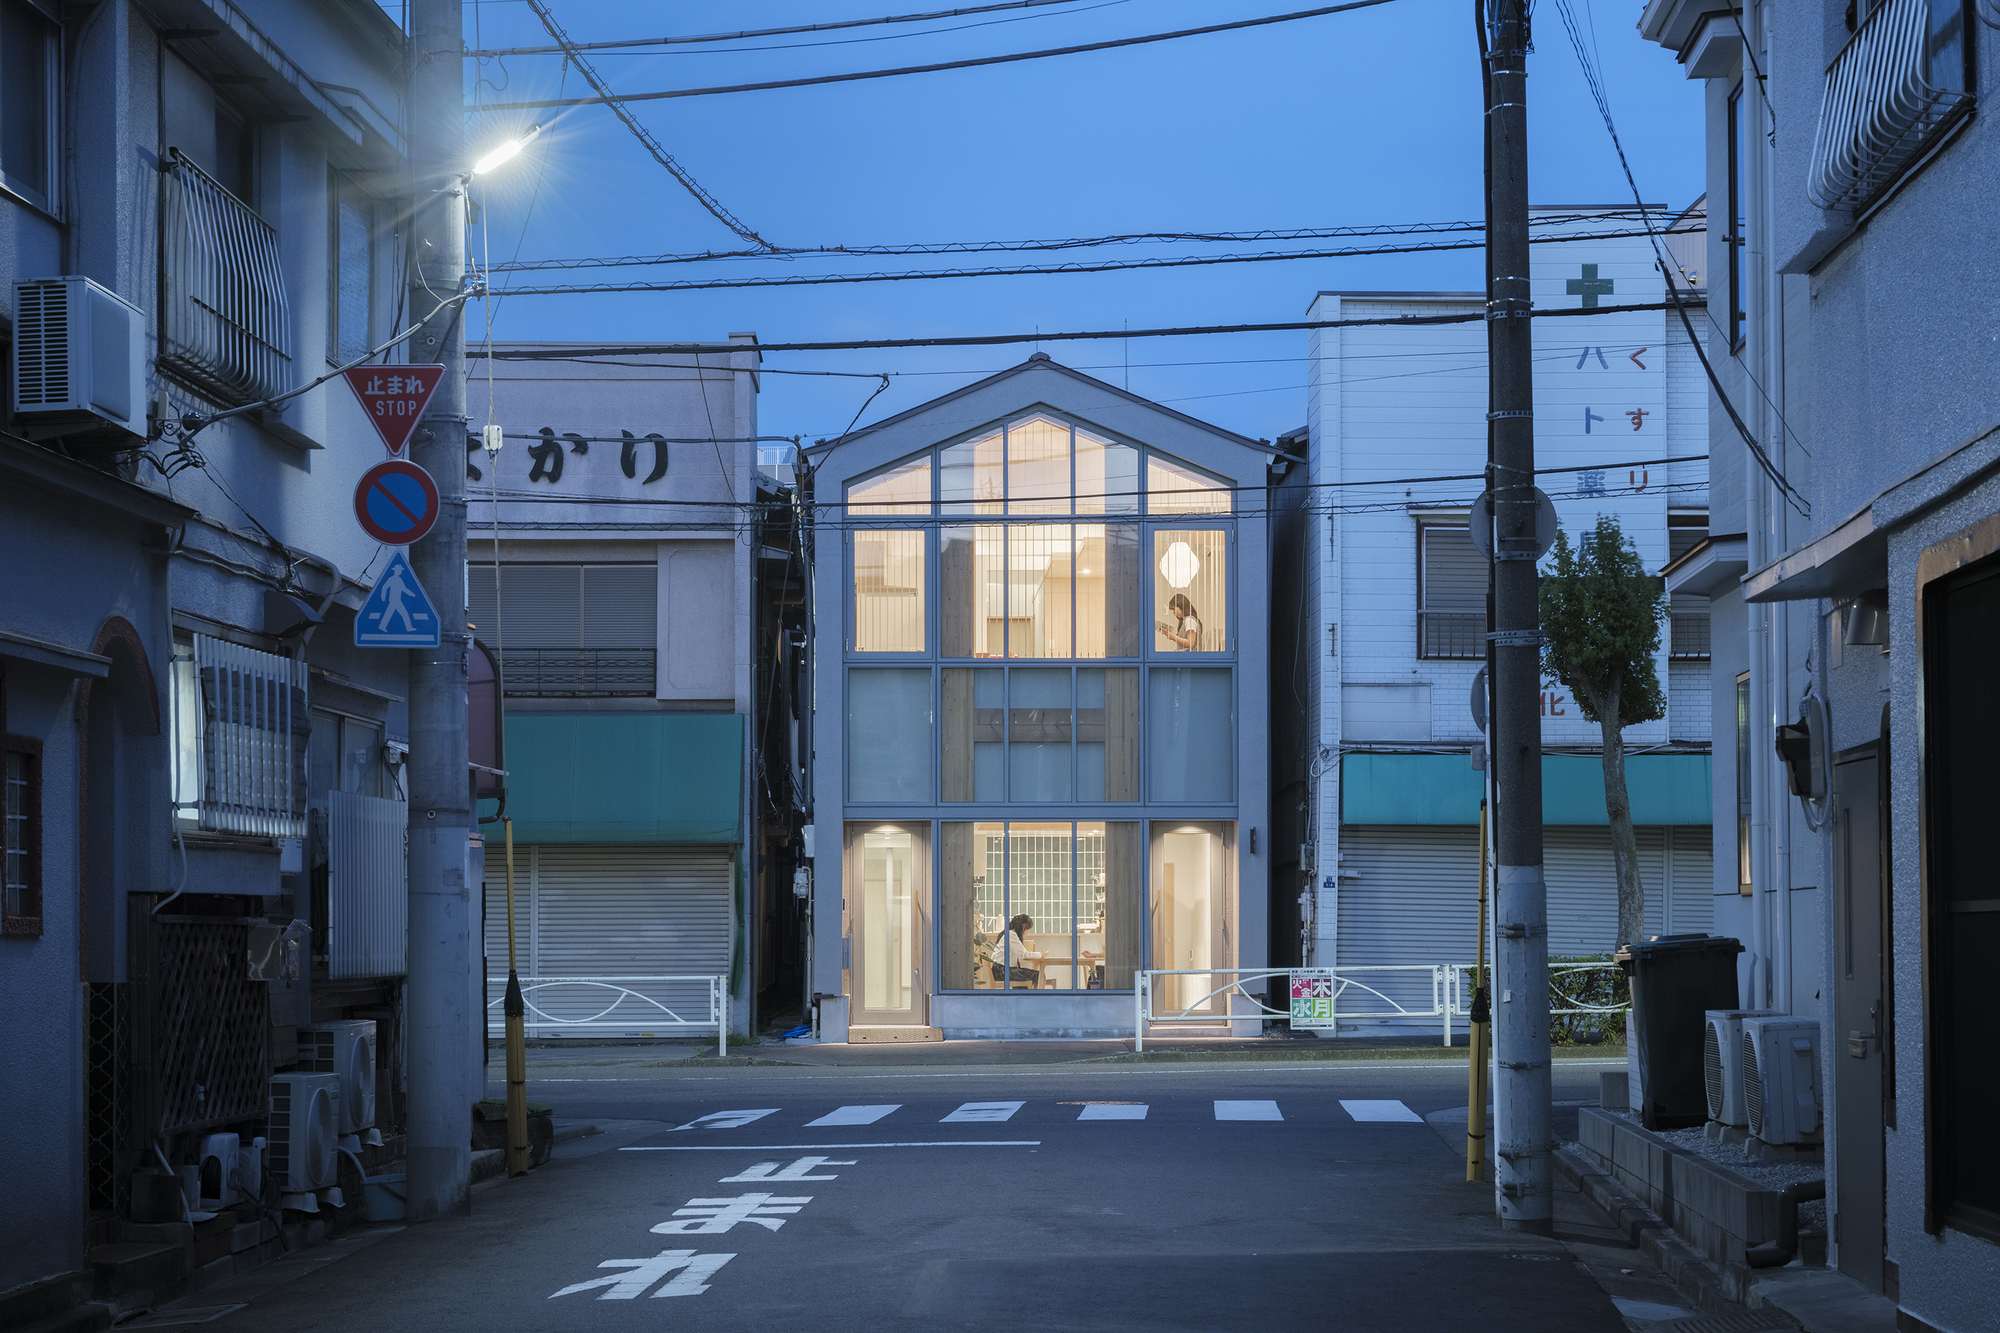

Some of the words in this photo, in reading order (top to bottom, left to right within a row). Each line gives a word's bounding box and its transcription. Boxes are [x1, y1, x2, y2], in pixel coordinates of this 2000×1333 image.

[365, 375, 425, 395] 止まれ
[376, 400, 416, 416] STOP
[1312, 978, 1331, 998] 木
[1292, 999, 1311, 1017] 水
[1313, 999, 1331, 1017] 月
[547, 1156, 859, 1300] 止まれ
